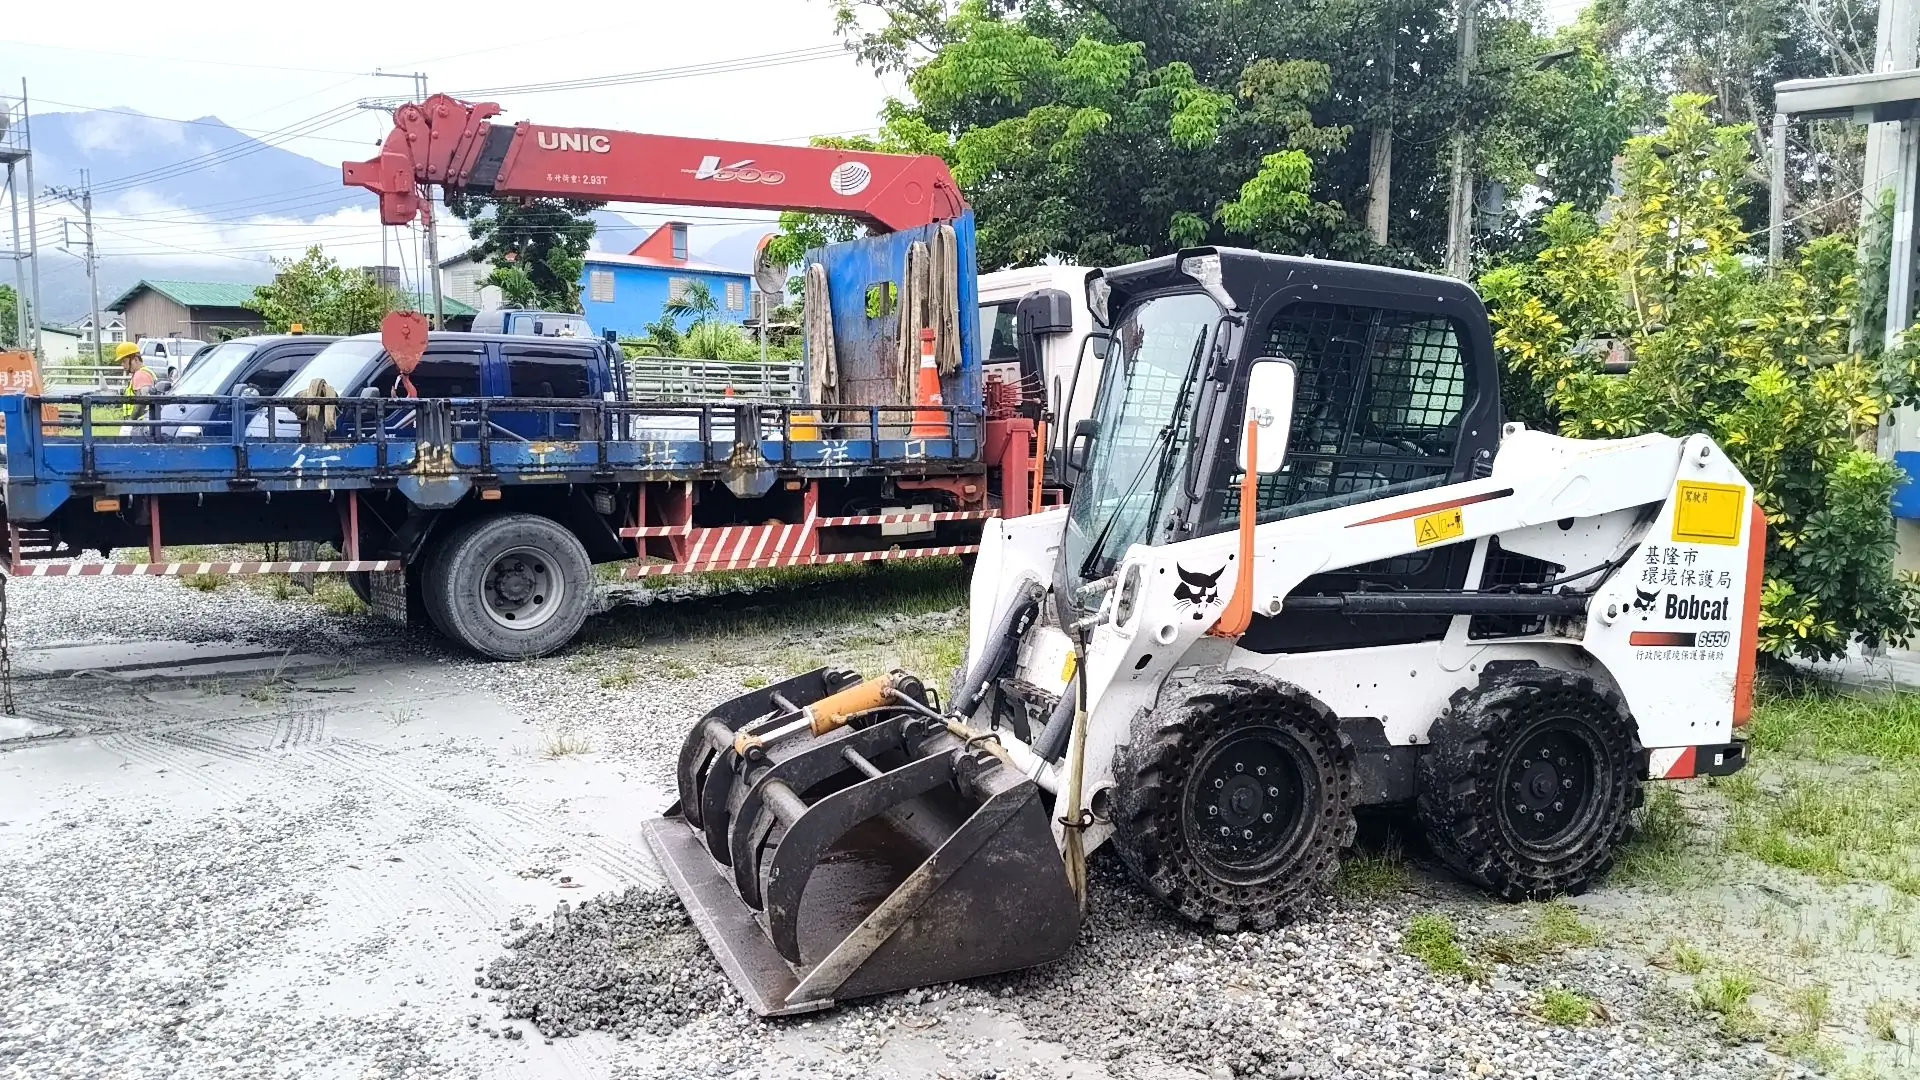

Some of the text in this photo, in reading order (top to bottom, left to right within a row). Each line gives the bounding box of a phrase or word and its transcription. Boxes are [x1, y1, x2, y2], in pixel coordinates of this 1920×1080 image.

[537, 131, 611, 154] UNIC
[1645, 545, 1699, 567] 基隆市
[1641, 566, 1732, 589] 環境保護局
[1665, 593, 1729, 621] Bobcat
[1697, 630, 1731, 648] S550
